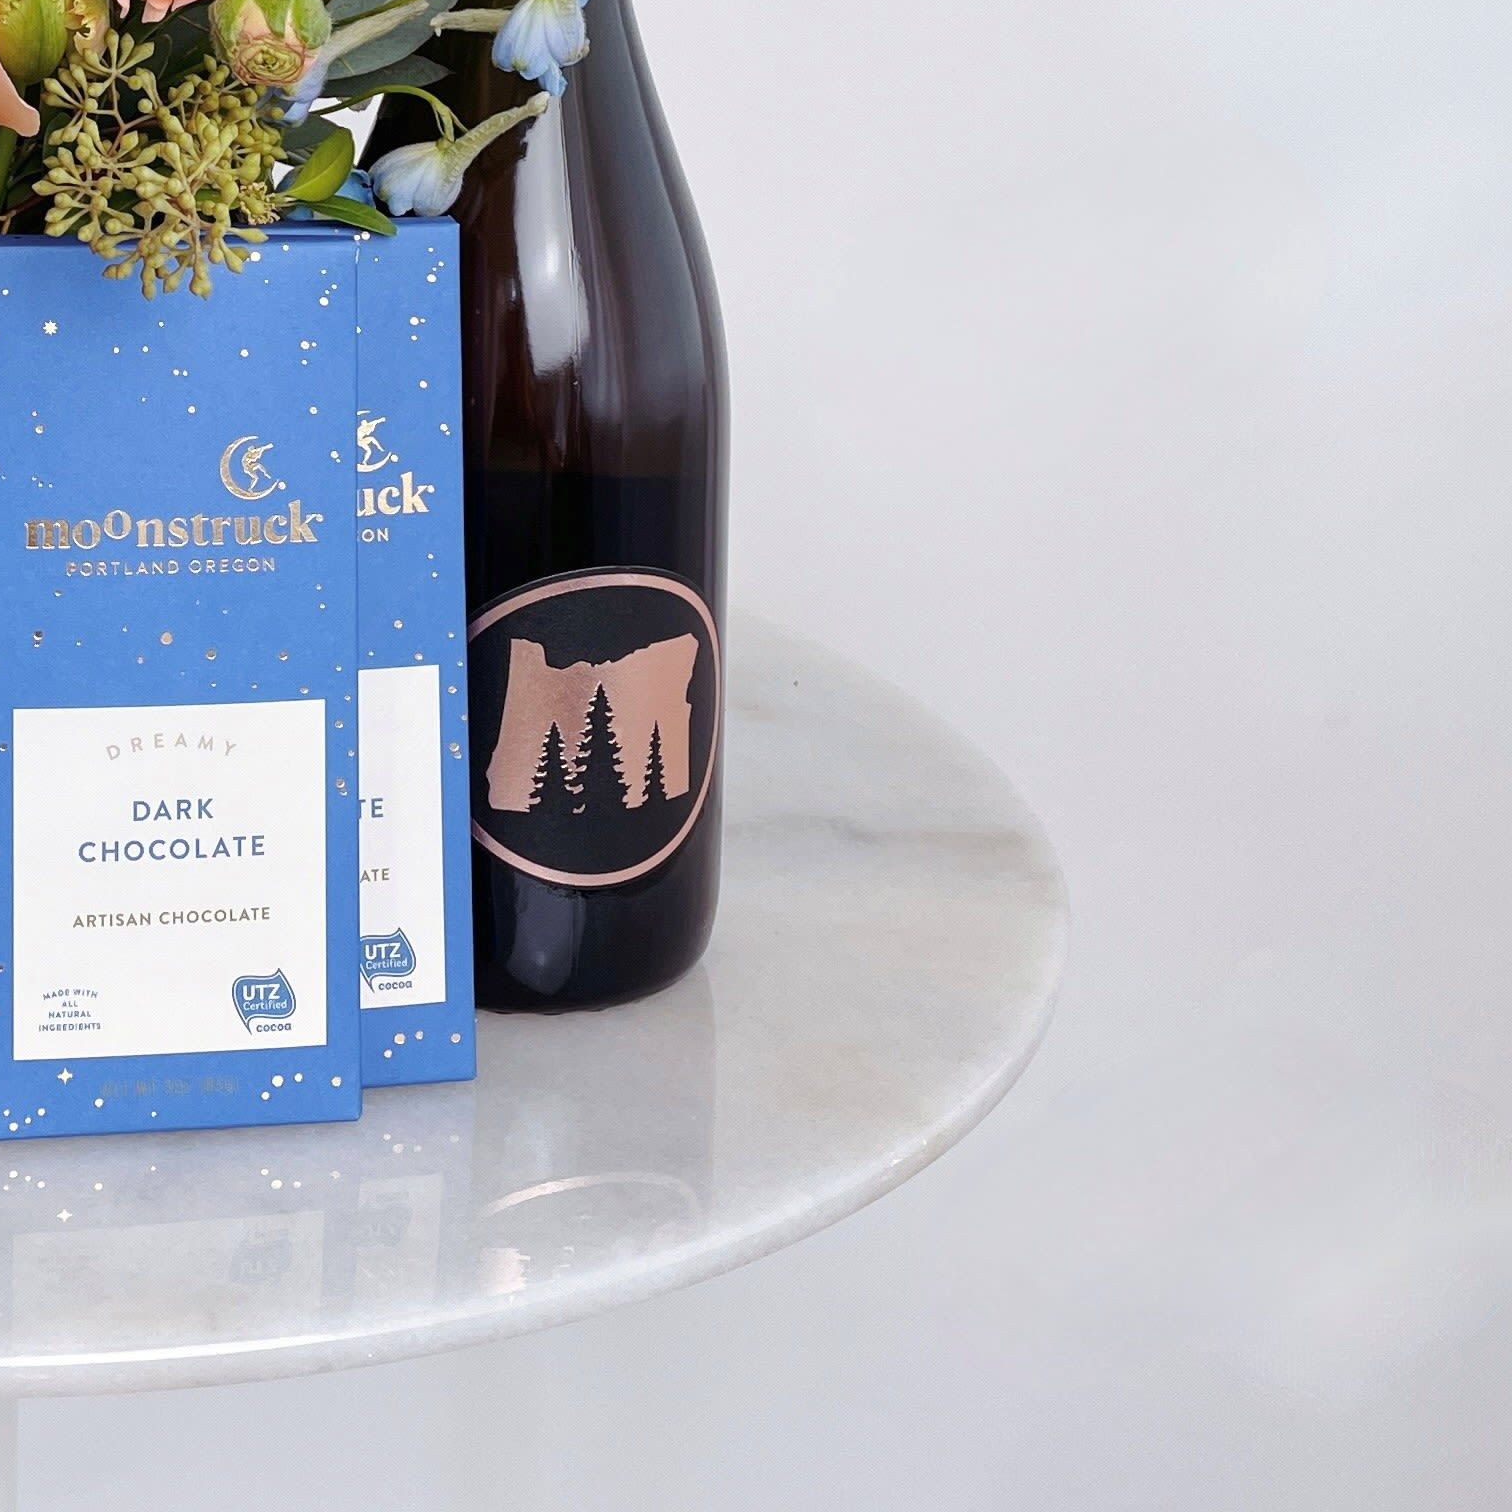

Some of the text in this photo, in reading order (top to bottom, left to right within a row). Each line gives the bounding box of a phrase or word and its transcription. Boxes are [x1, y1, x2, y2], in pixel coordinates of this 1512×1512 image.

[24, 499, 325, 550] moonstruck
[65, 556, 276, 577] PORTLAND OREGON
[105, 732, 237, 761] DREAMY
[132, 798, 214, 822] DARK
[78, 835, 265, 863] CHOCOLATE
[72, 906, 270, 928] ARTISAN CHOCOLATE
[365, 942, 401, 960] UTZ
[365, 957, 408, 970] Certified
[242, 983, 281, 1001] UTZ
[377, 980, 413, 991] cocoa
[42, 988, 99, 1000] MADE WITH
[61, 1000, 79, 1008] ALL
[242, 999, 288, 1011] Certified
[48, 1010, 92, 1019] NATURAL
[38, 1022, 101, 1032] INGREDIENTS
[255, 1023, 293, 1033] cocoa
